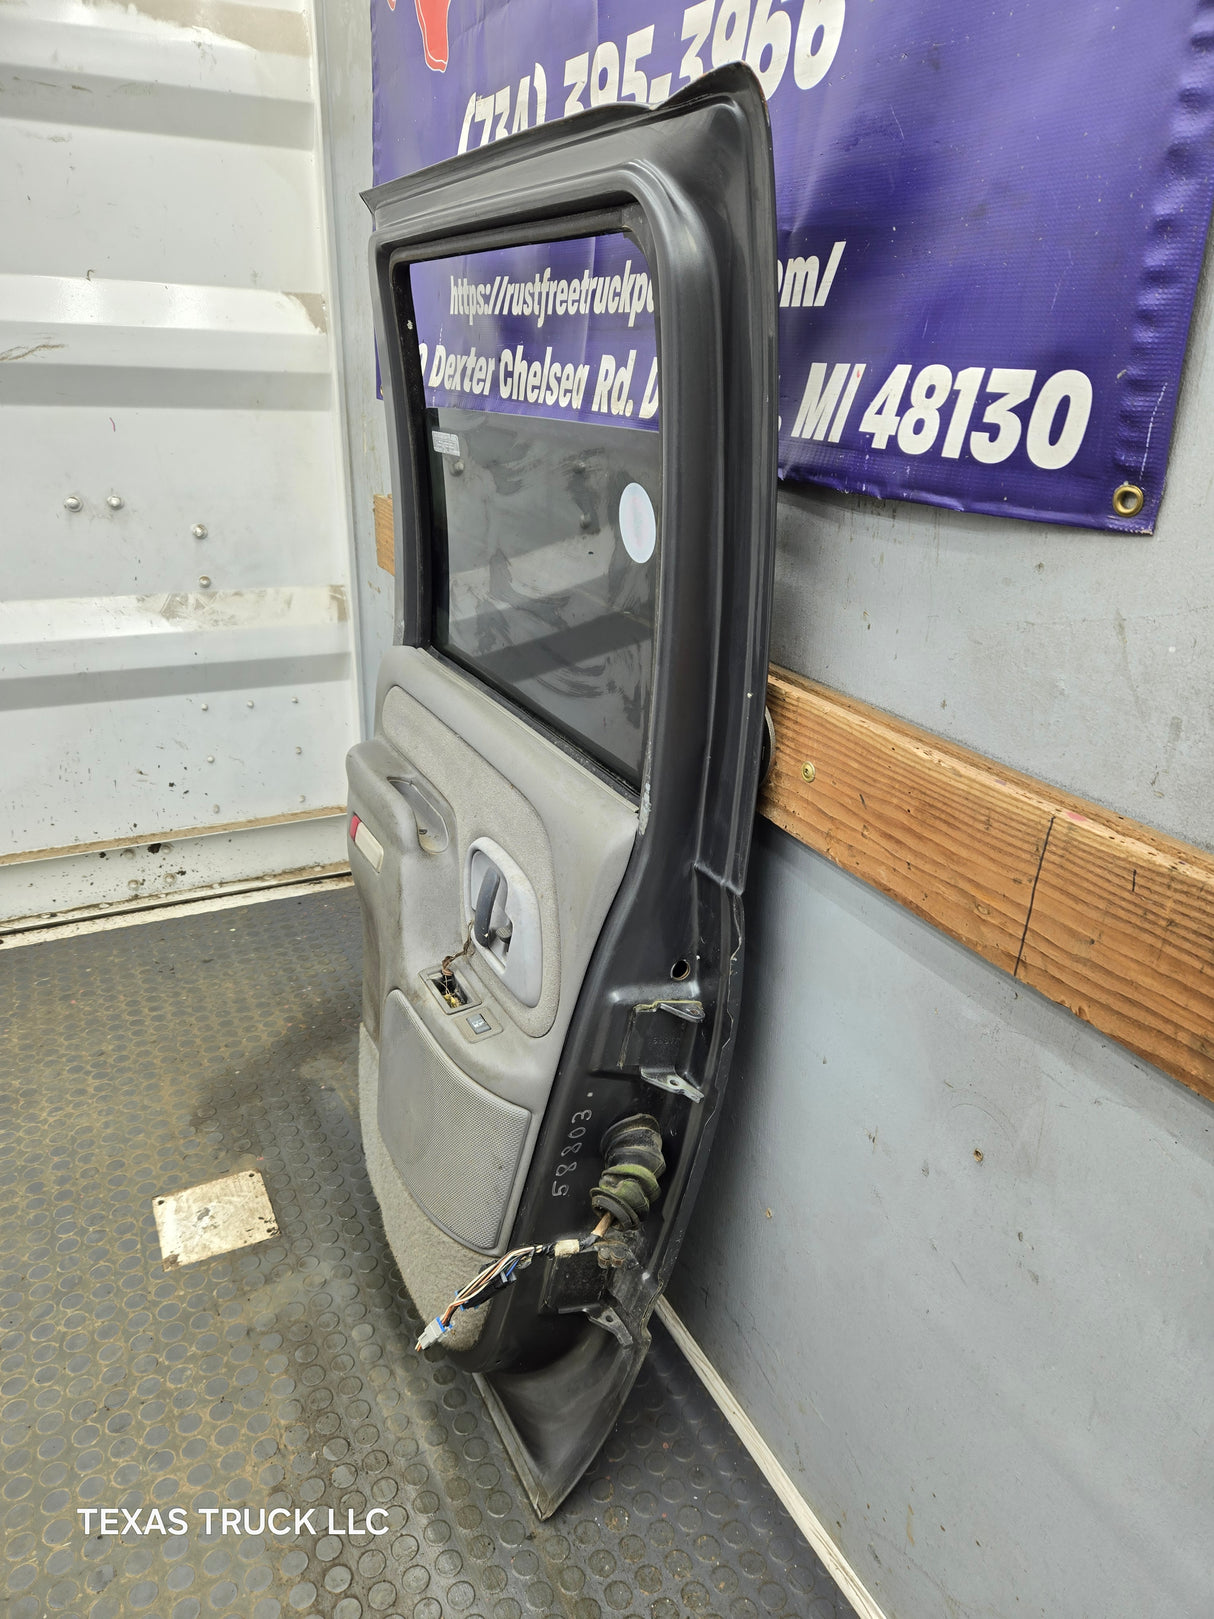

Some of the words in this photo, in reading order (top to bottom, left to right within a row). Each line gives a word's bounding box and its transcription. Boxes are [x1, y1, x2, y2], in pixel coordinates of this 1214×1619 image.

[457, 62, 547, 156] (734)
[777, 241, 846, 307] m/
[428, 344, 496, 396] Dexter
[499, 345, 590, 410] Chelsea
[591, 349, 637, 417] Rd.
[790, 362, 867, 443] MI
[858, 364, 1093, 470] 48130
